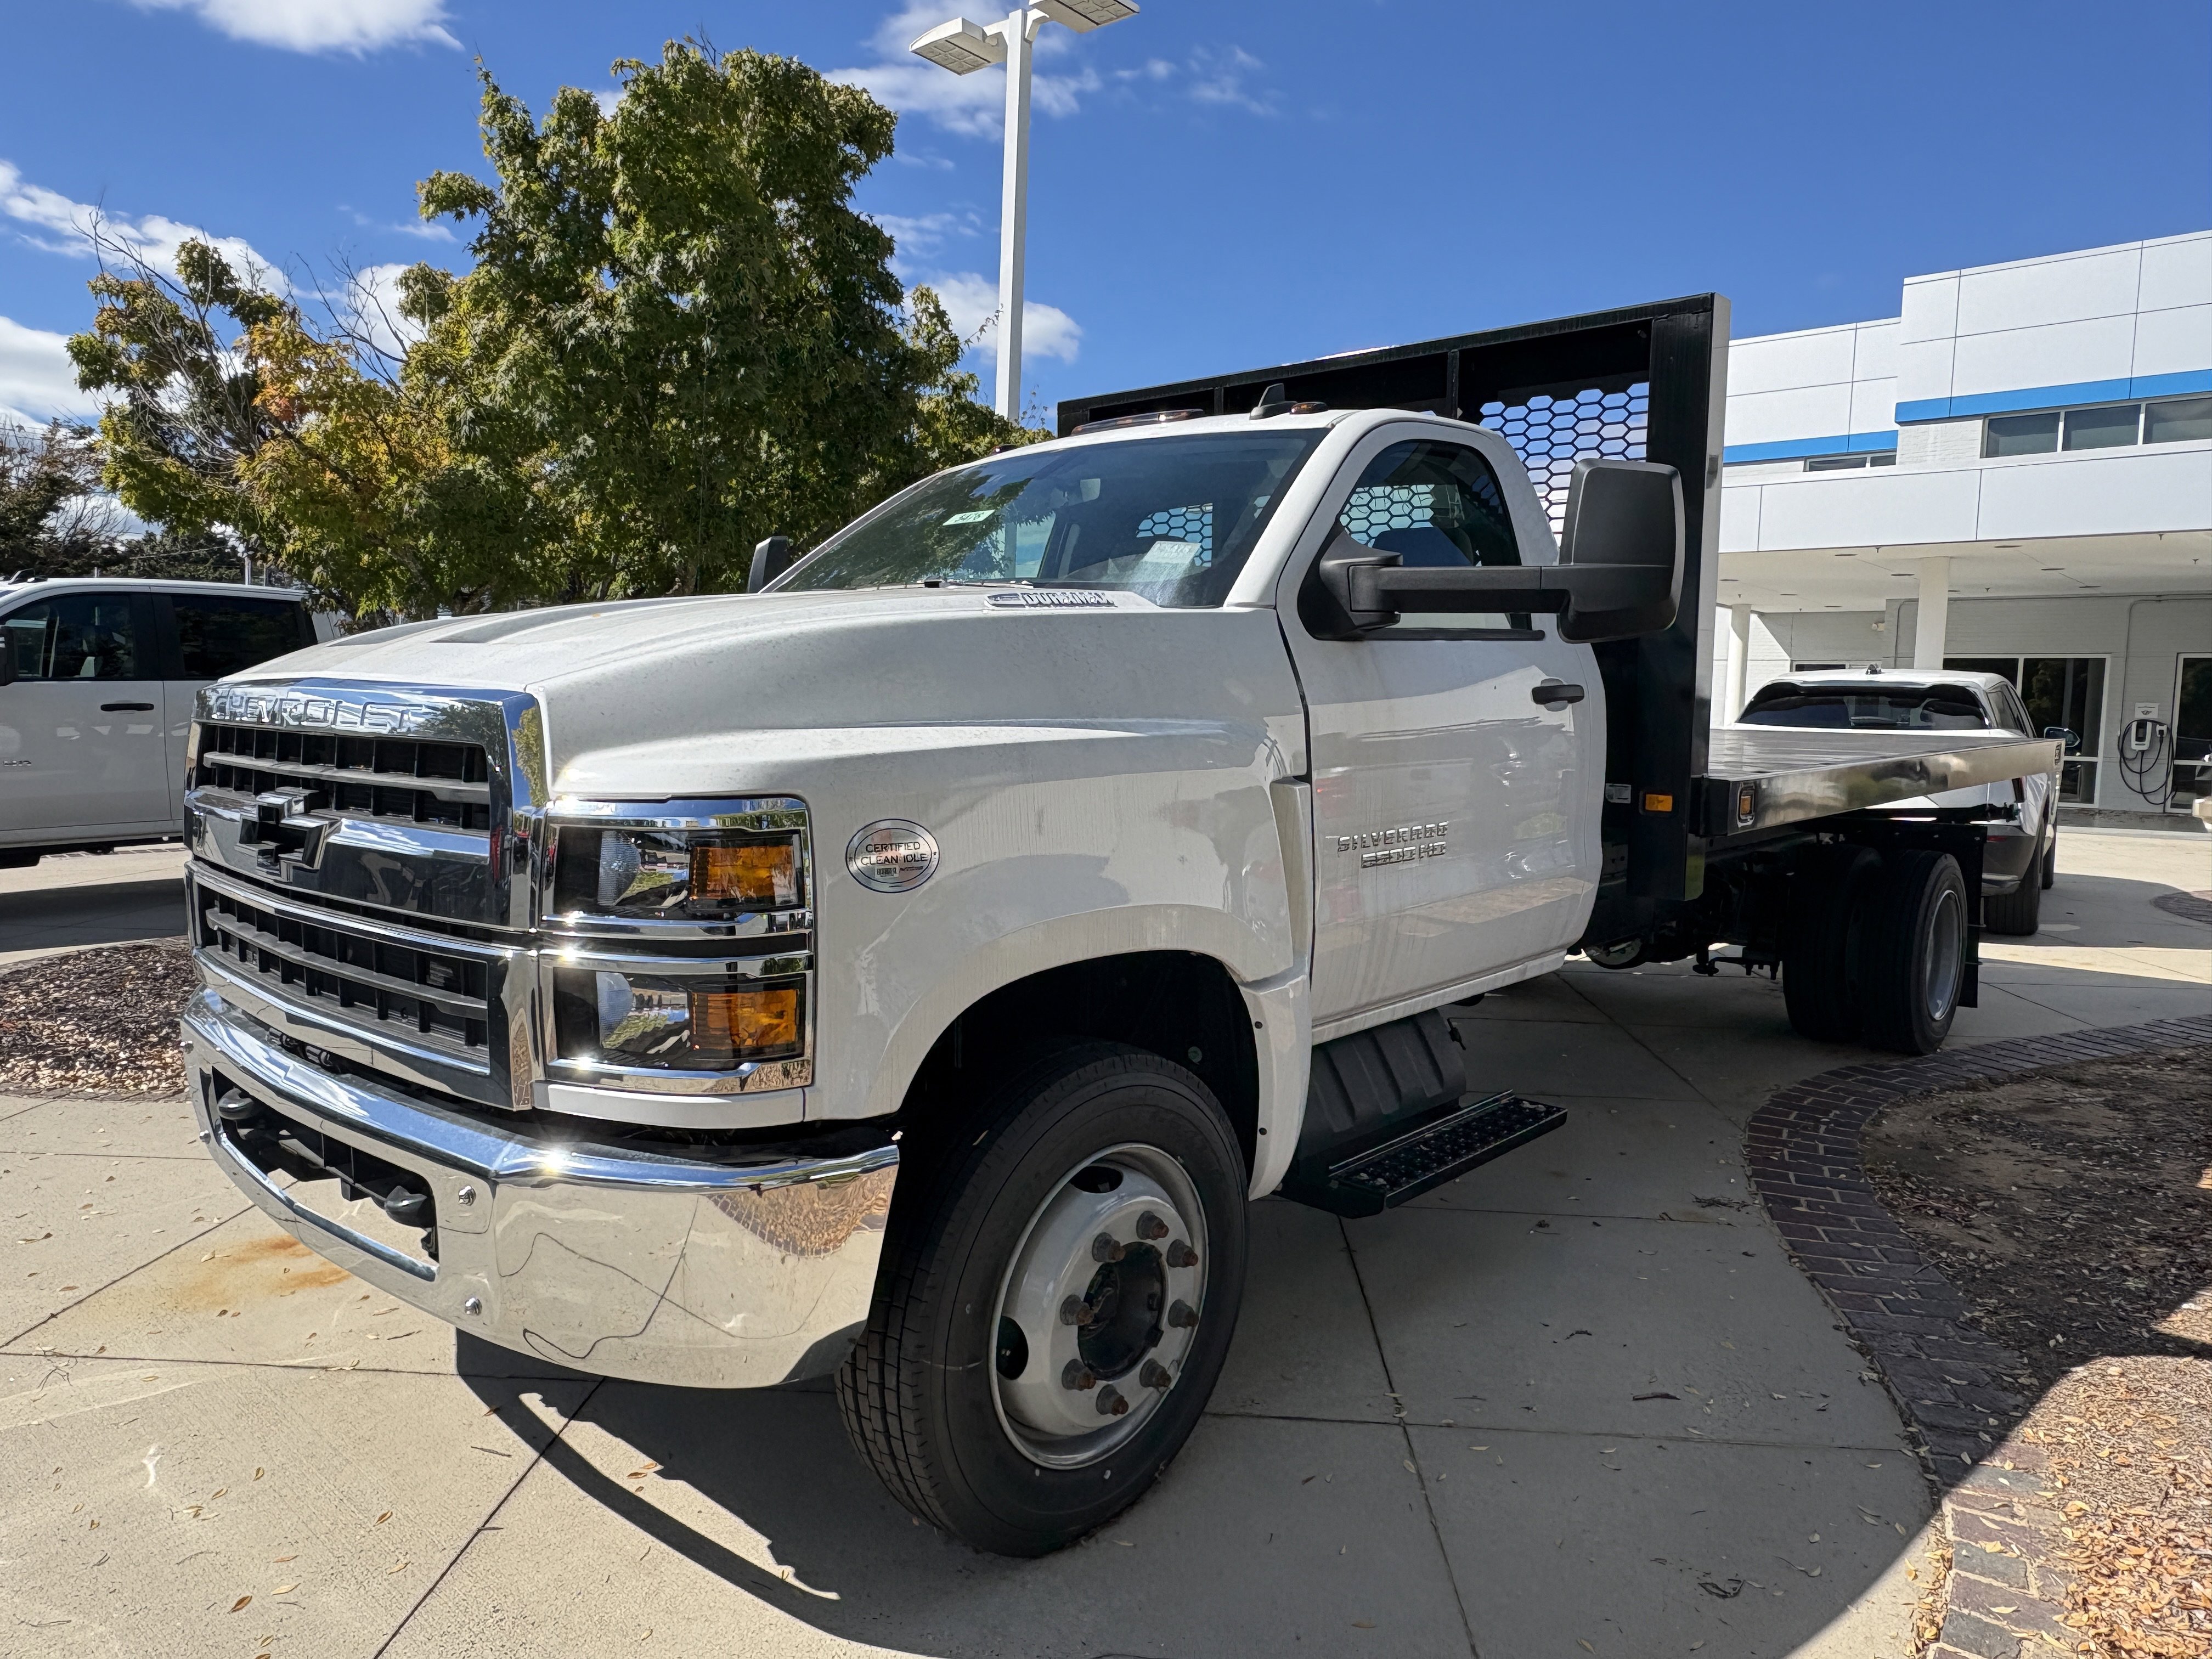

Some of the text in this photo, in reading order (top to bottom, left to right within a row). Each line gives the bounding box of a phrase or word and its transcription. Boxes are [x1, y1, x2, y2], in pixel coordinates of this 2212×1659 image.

[211, 694, 424, 733] CHEVROLET
[866, 842, 921, 853] CERTIFIED
[1338, 822, 1449, 853] SILVERADO
[860, 853, 928, 866] CLEAN IDLE
